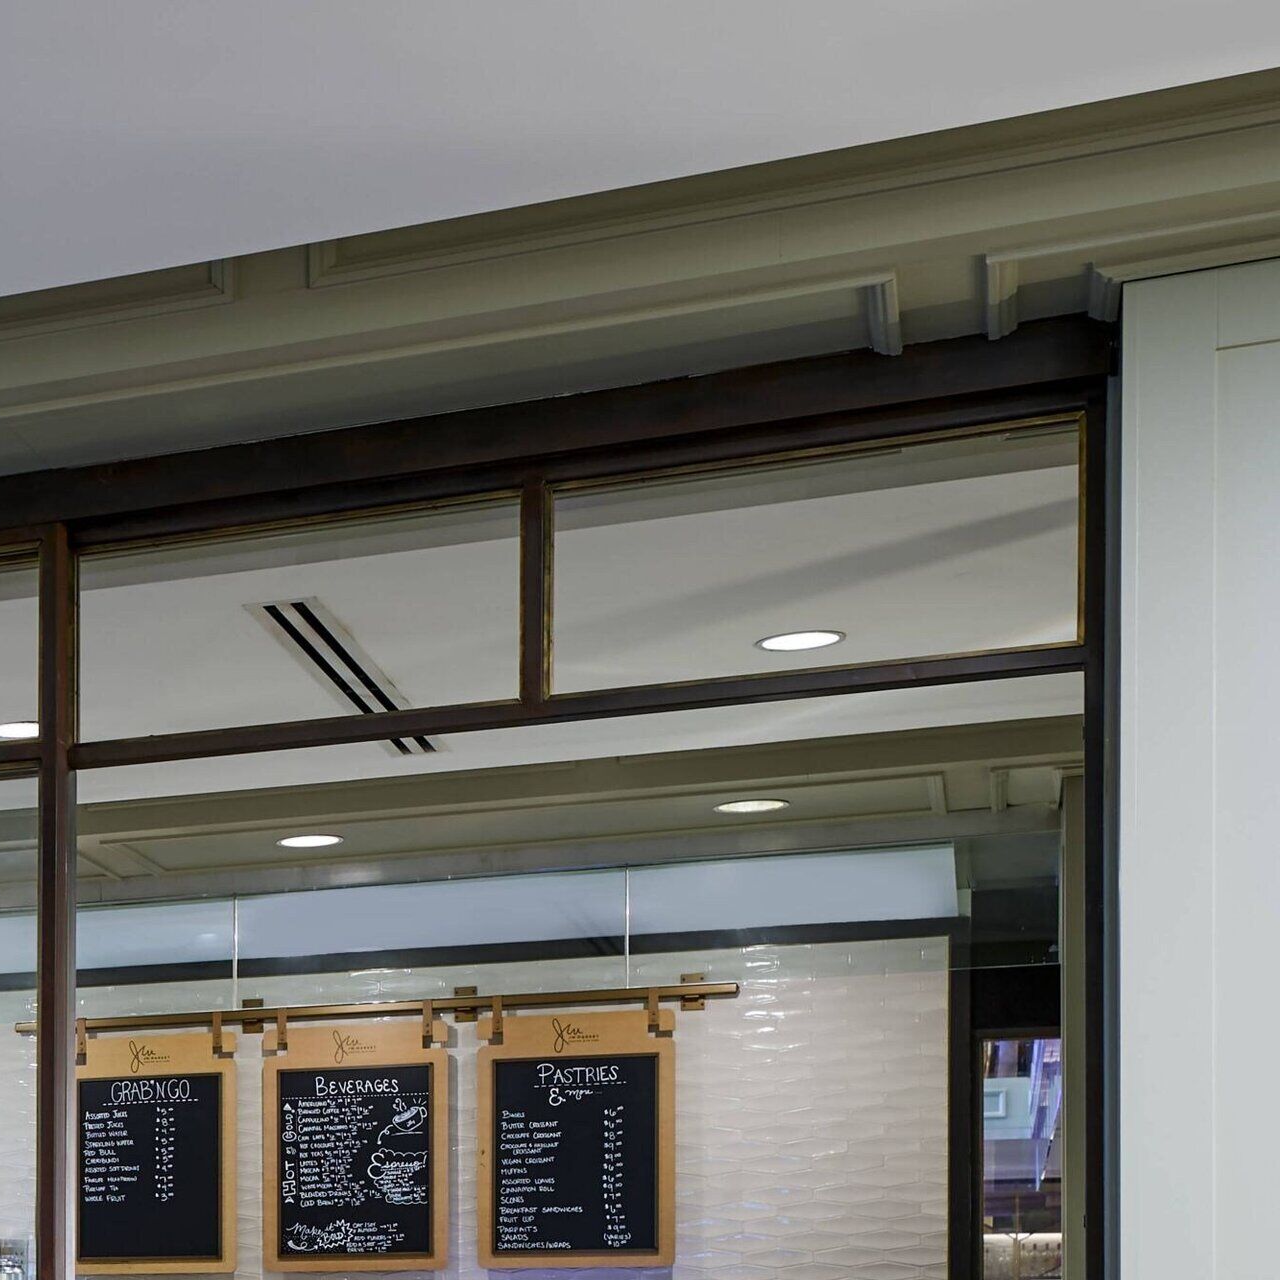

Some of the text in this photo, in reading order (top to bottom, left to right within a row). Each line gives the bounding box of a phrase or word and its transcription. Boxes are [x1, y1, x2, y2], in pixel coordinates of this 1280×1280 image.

[537, 1063, 619, 1085] PASTRIES
[315, 1076, 399, 1096] BEVERAGES
[282, 1160, 296, 1197] HOT
